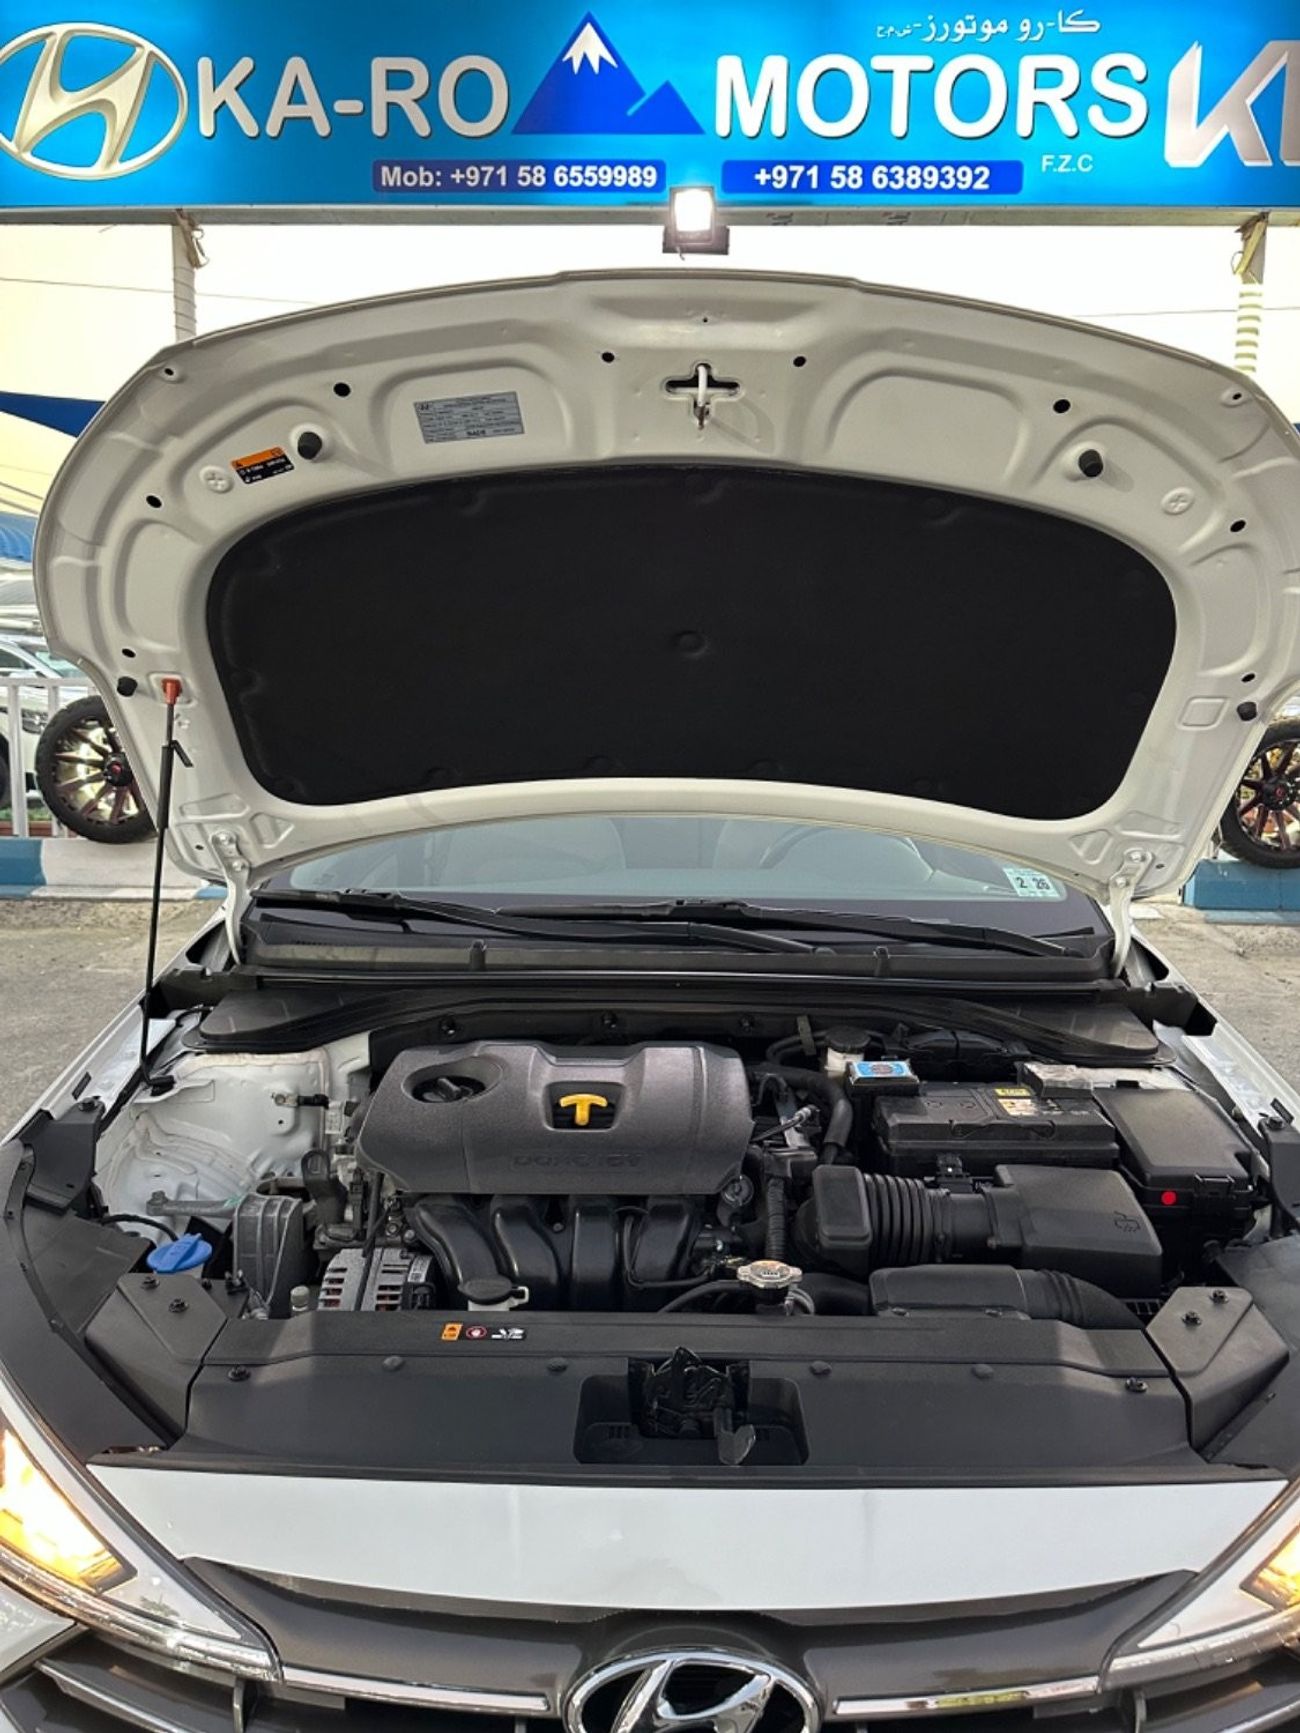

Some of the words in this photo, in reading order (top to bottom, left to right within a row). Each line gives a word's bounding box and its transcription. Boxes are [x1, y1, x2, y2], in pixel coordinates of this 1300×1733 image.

[197, 55, 509, 138] KA-RO
[715, 53, 1148, 138] MOTORS
[381, 166, 442, 187] Mob:
[450, 165, 507, 187] +971
[517, 165, 546, 187] 58
[553, 164, 658, 187] 6559989
[1041, 154, 1094, 173] F.Z.C
[754, 165, 819, 189] +971
[830, 164, 863, 189] 58
[871, 164, 990, 190] 6389392
